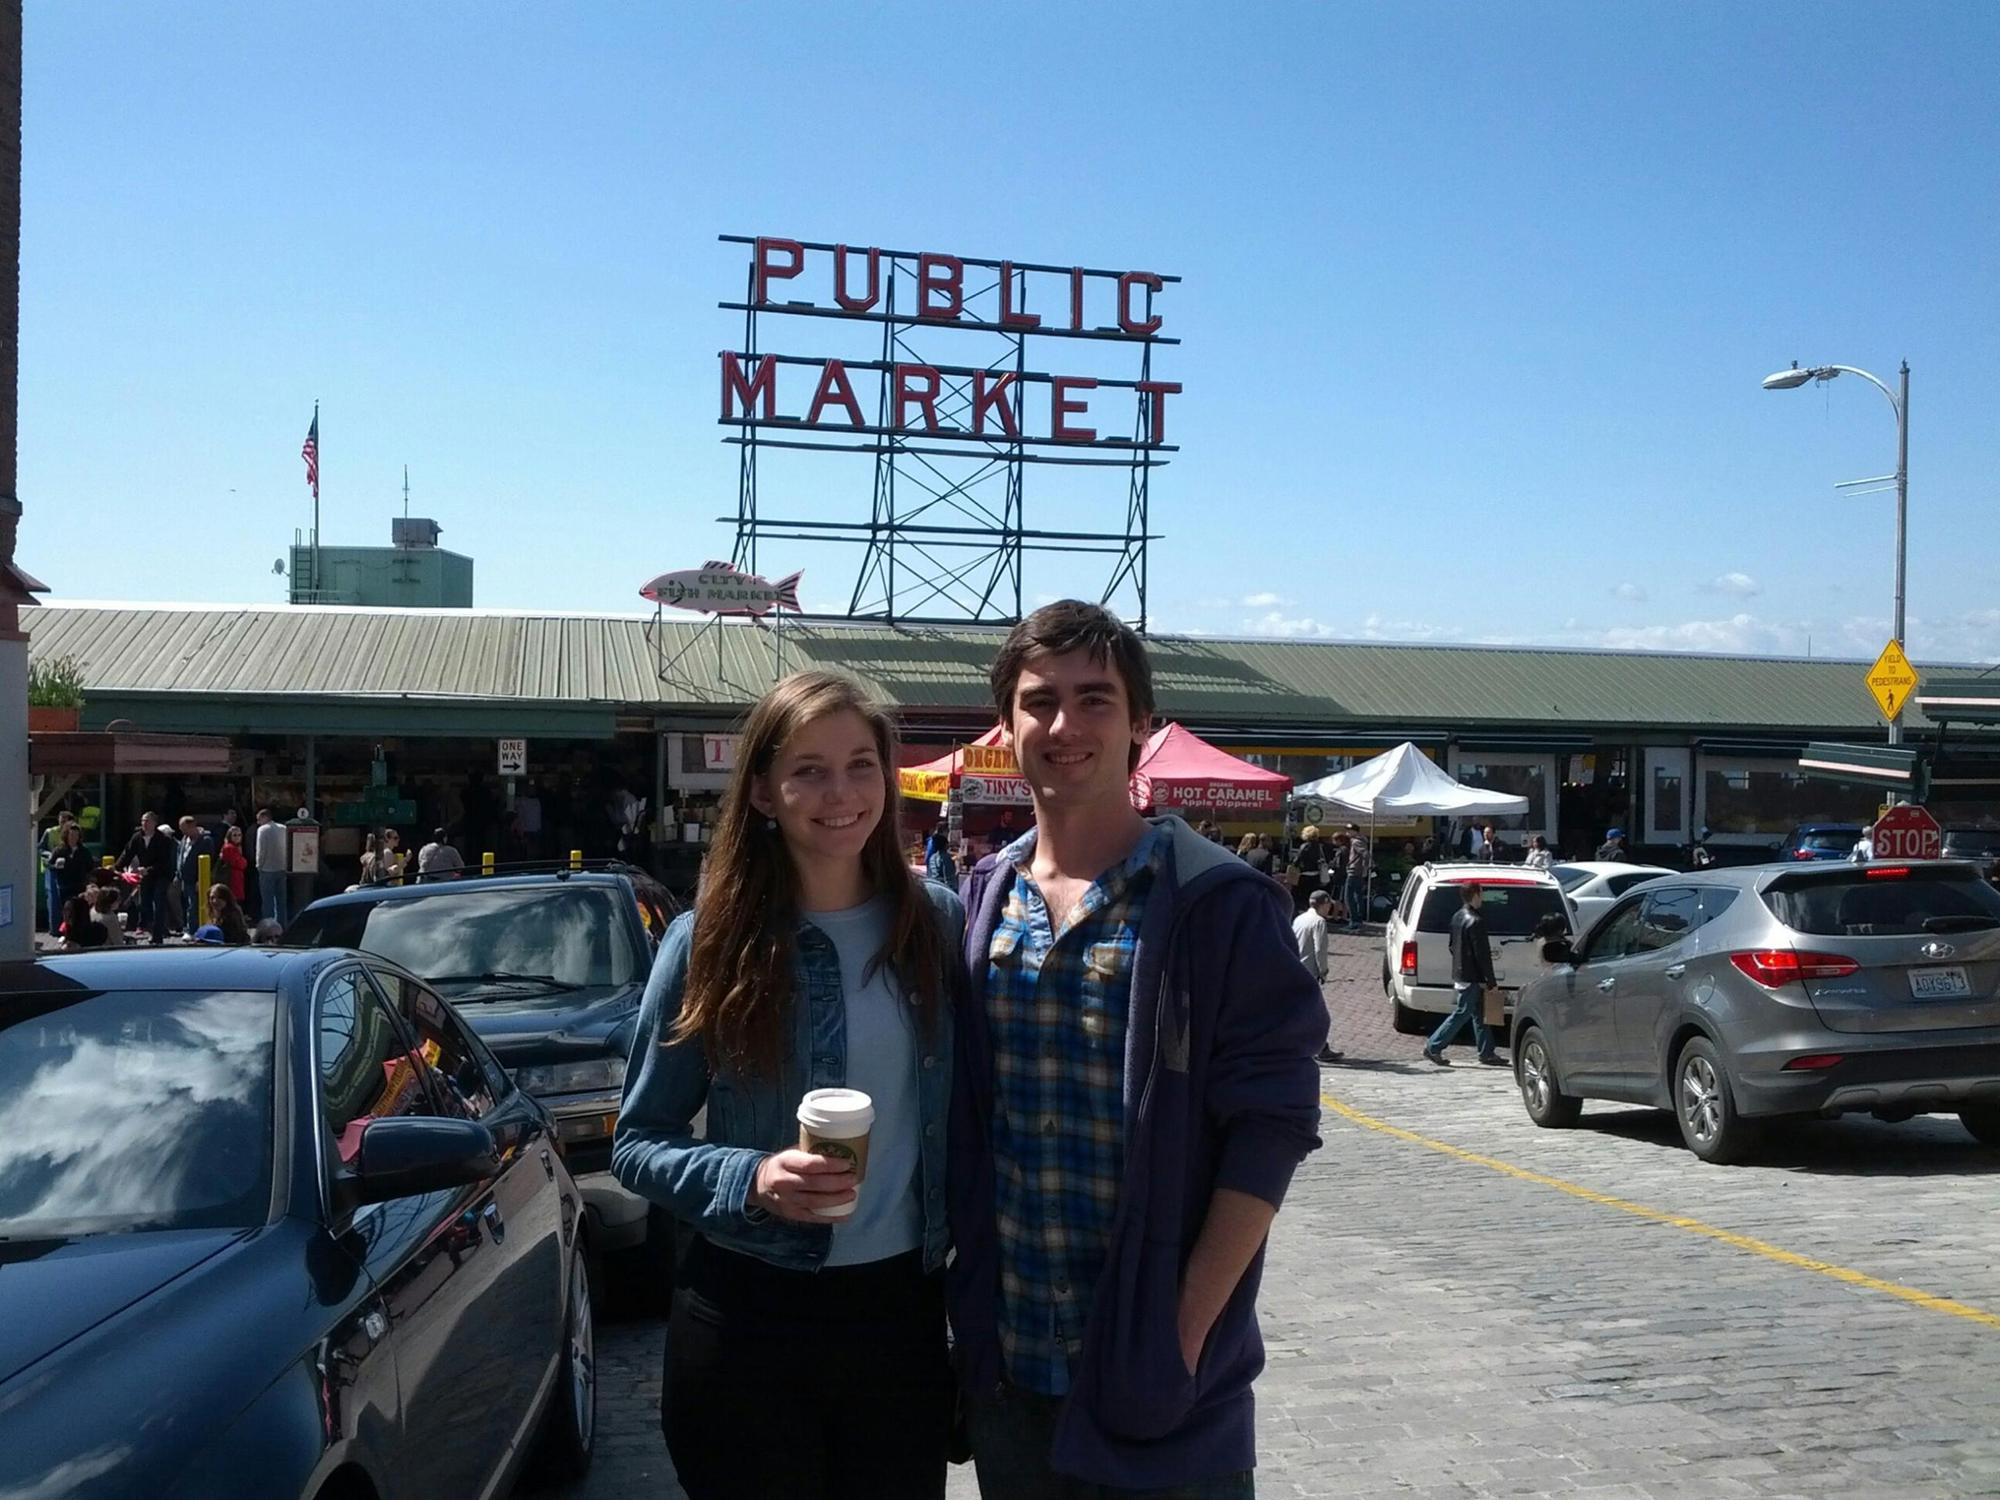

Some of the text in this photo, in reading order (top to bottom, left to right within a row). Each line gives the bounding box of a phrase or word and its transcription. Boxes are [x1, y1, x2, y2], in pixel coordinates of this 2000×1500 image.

[755, 236, 1163, 334] PUBLIC
[720, 351, 1182, 445] MARKET
[698, 574, 746, 586] CITY
[656, 587, 784, 601] FISH MARKET
[1884, 654, 1902, 664] YIELD
[1888, 665, 1897, 674] TO
[1871, 676, 1913, 687] PEDESTRIANS
[502, 742, 523, 751] ONE
[501, 752, 523, 760] WAY
[983, 779, 1032, 797] TINY'S
[1173, 787, 1273, 801] HOT CARAMEL
[1181, 799, 1262, 808] Apple Dippers!
[1877, 829, 1938, 856] STOP
